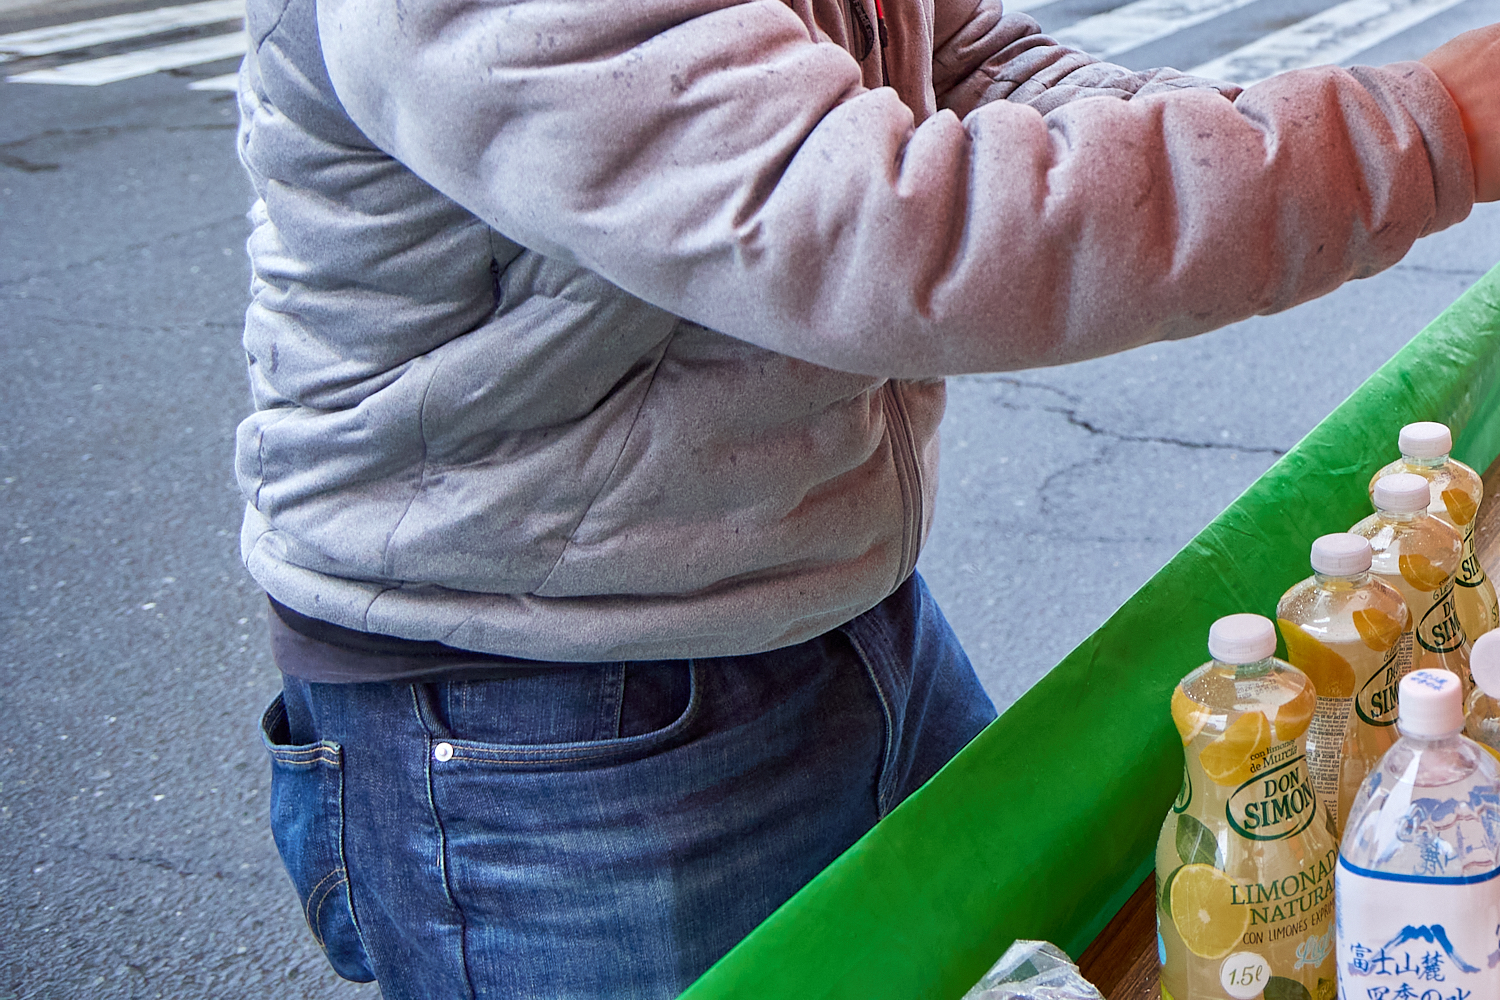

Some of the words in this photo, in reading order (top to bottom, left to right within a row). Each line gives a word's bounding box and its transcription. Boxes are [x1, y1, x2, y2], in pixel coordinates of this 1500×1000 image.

[1250, 750, 1266, 761] con
[1250, 763, 1262, 774] de
[1263, 745, 1298, 769] Murcia
[1264, 766, 1299, 799] DON
[1243, 776, 1314, 830] SIMON
[1230, 848, 1339, 906] LIMONAD
[1242, 930, 1264, 945] CON
[1268, 919, 1308, 942] LIMONES
[1350, 943, 1446, 982] 富士山麓
